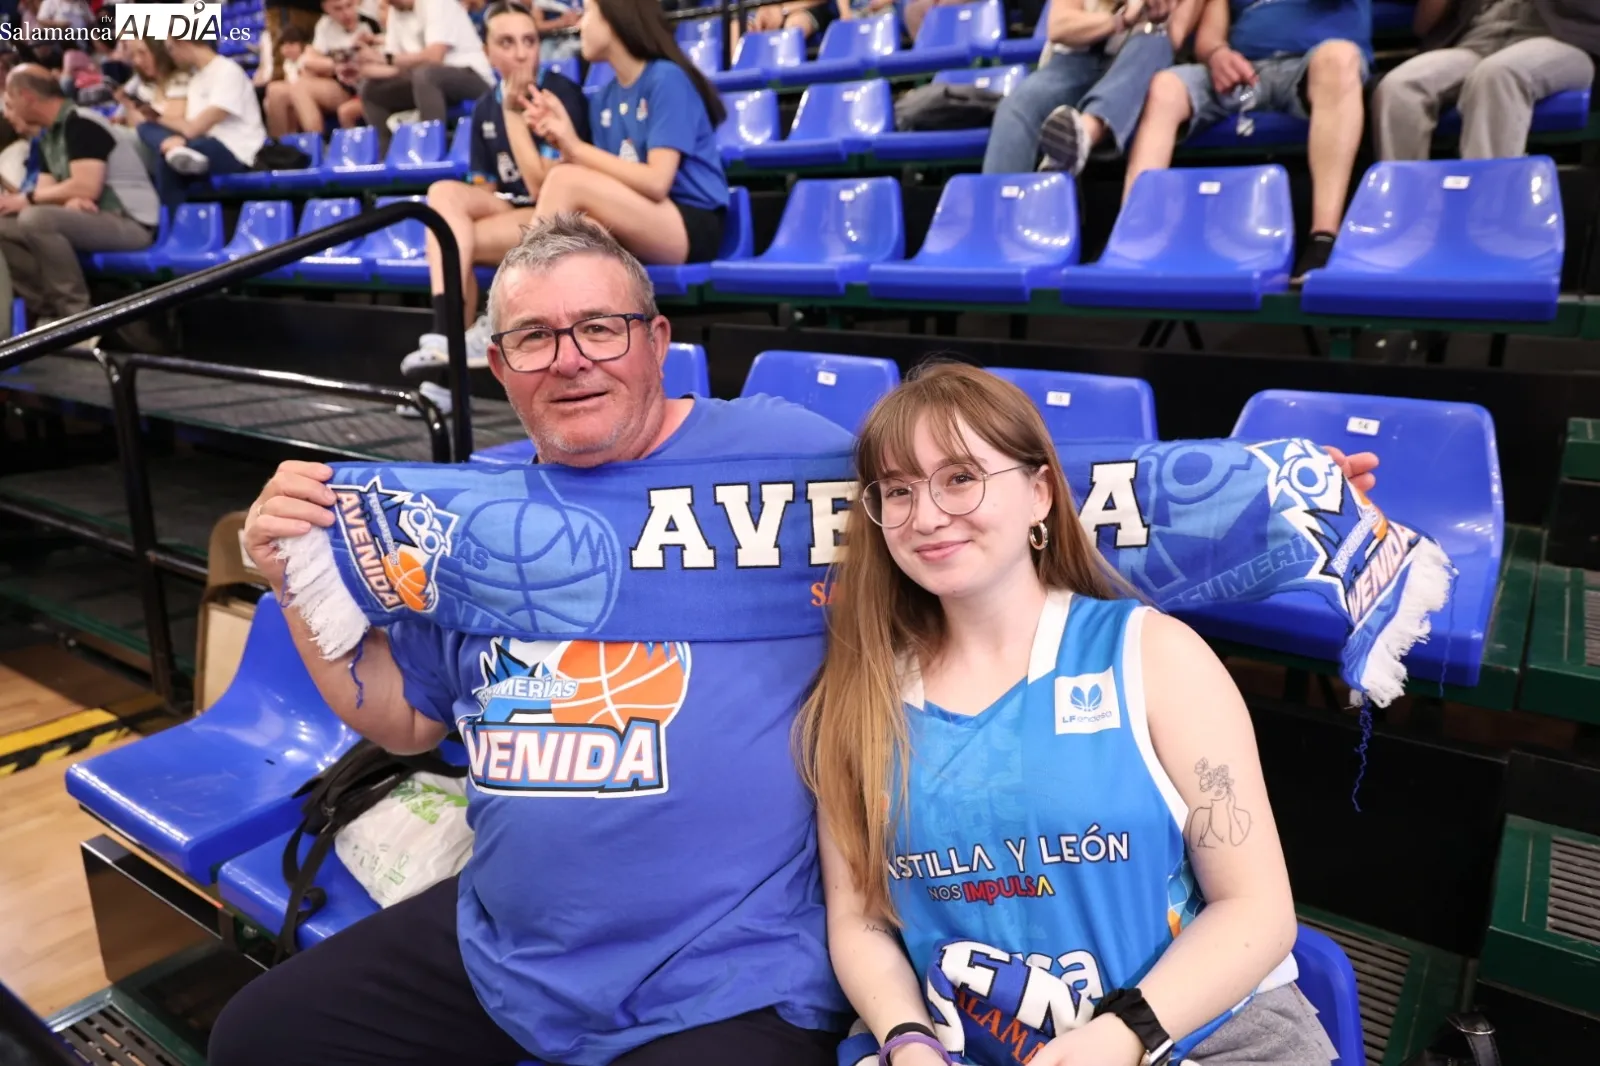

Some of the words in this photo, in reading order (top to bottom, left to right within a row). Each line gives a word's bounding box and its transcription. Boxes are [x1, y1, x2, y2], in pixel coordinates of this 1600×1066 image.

[336, 491, 403, 609] AVENIDA
[1345, 520, 1419, 625] VENIDA
[464, 725, 655, 783] VENIDA
[1004, 838, 1027, 873] Y
[1037, 822, 1130, 866] LEÓN
[927, 885, 962, 902] NOS
[962, 873, 1056, 905] IMPULSA
